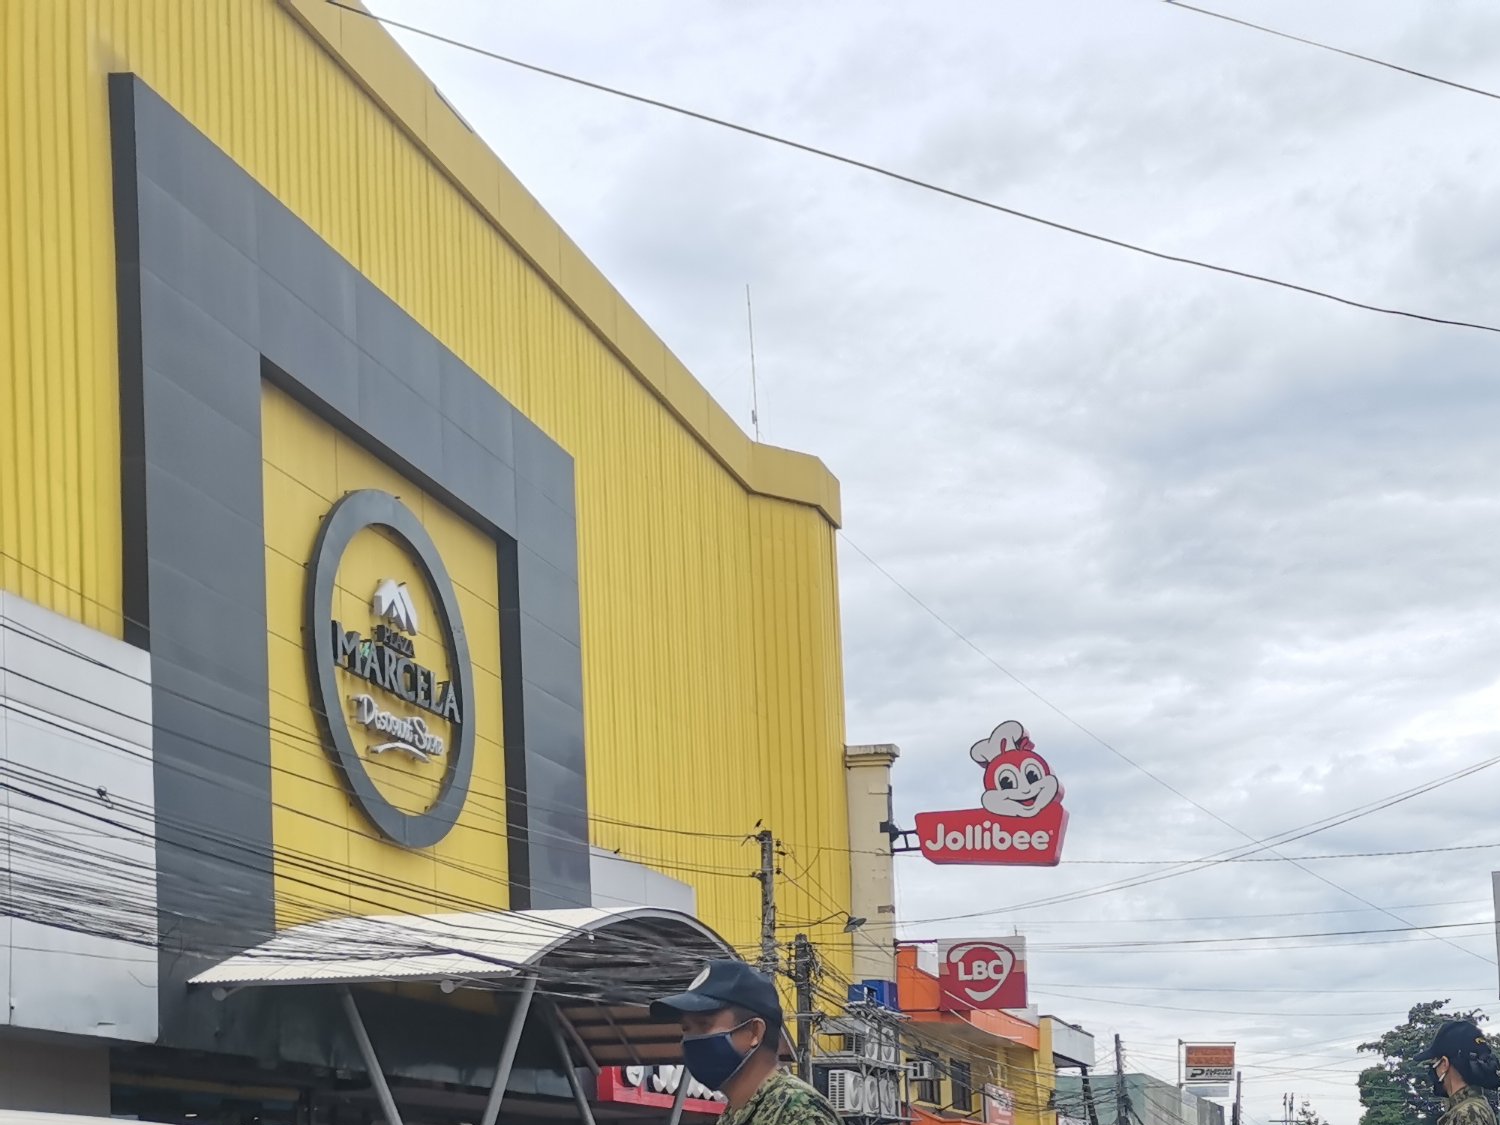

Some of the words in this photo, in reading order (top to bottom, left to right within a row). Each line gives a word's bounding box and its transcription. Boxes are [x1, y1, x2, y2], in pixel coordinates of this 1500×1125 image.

[383, 626, 415, 658] PLAZA
[331, 620, 462, 724] MARCELA
[925, 820, 1049, 851] Jollibee
[958, 960, 1004, 981] LBC
